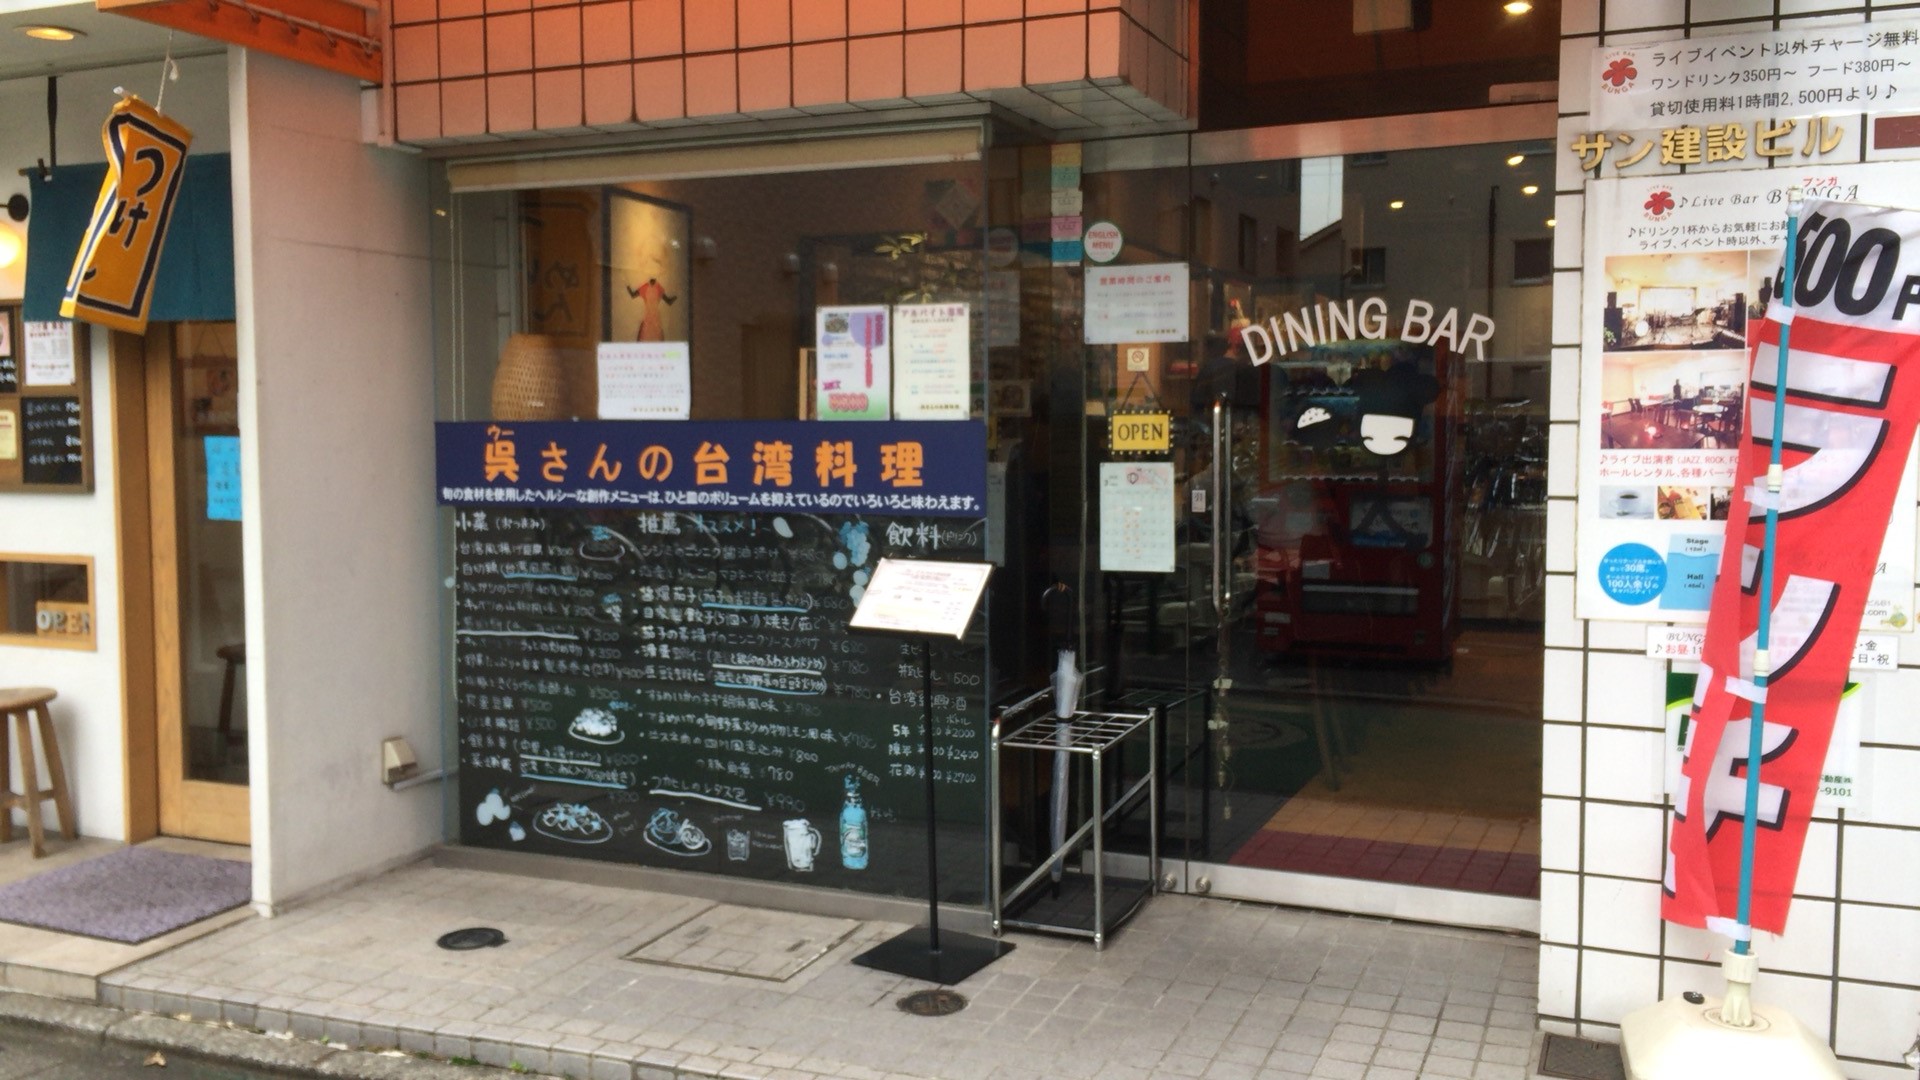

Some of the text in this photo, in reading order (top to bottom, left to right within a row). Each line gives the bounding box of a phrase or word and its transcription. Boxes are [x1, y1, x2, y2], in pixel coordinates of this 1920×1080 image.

[1652, 30, 1919, 67] ライブイベント以外チャージ無料
[1602, 81, 1636, 95] BUNGA
[1571, 117, 1844, 171] サン建設ビル
[1802, 176, 1838, 187] ブンガ
[1690, 194, 1725, 208] Live
[1729, 193, 1760, 206] Bar
[1643, 211, 1673, 223] BUNGA
[1087, 230, 1119, 239] ENGLISH
[1092, 241, 1114, 249] MENU
[1240, 297, 1387, 367] DINING
[1401, 299, 1495, 361] BAR
[1118, 424, 1163, 441] OPEN
[485, 440, 923, 487] 呉さんの台湾料理
[886, 521, 941, 550] 飲料
[1686, 537, 1709, 545] Stage
[1666, 644, 1689, 655] お昼
